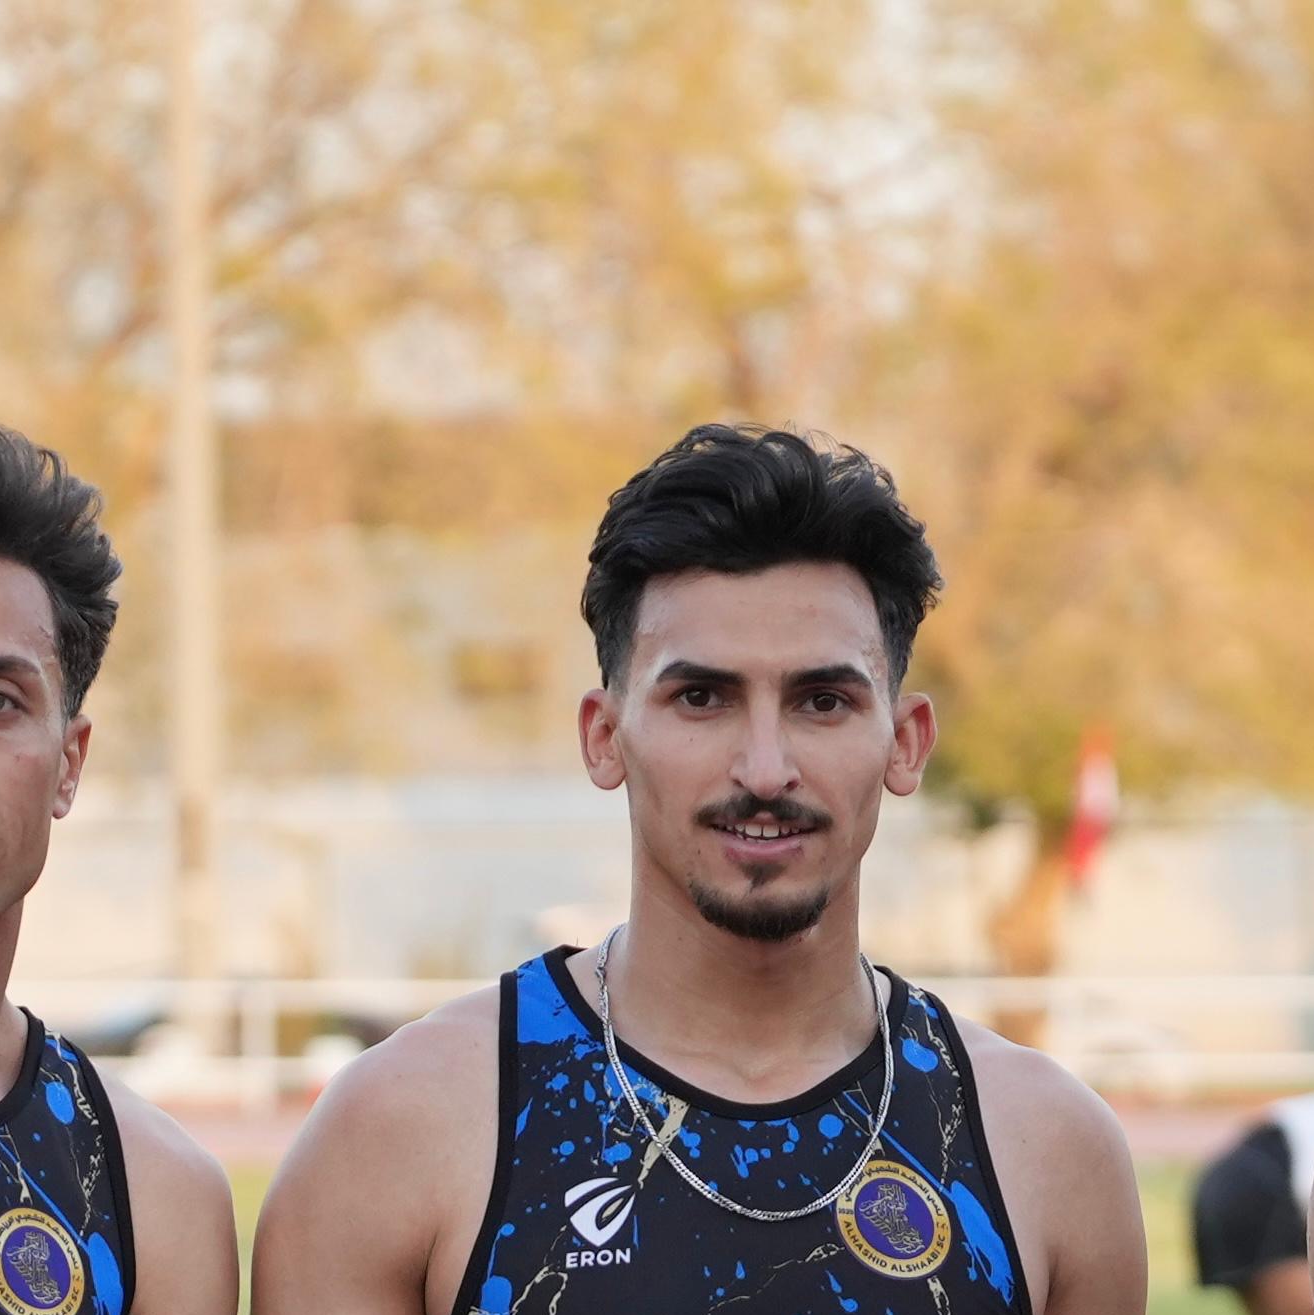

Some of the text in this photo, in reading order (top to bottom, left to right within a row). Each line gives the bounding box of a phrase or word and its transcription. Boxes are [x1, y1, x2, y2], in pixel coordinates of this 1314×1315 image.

[565, 1247, 631, 1269] ERON
[844, 1220, 945, 1272] ALHASHID ALSHAABI SC
